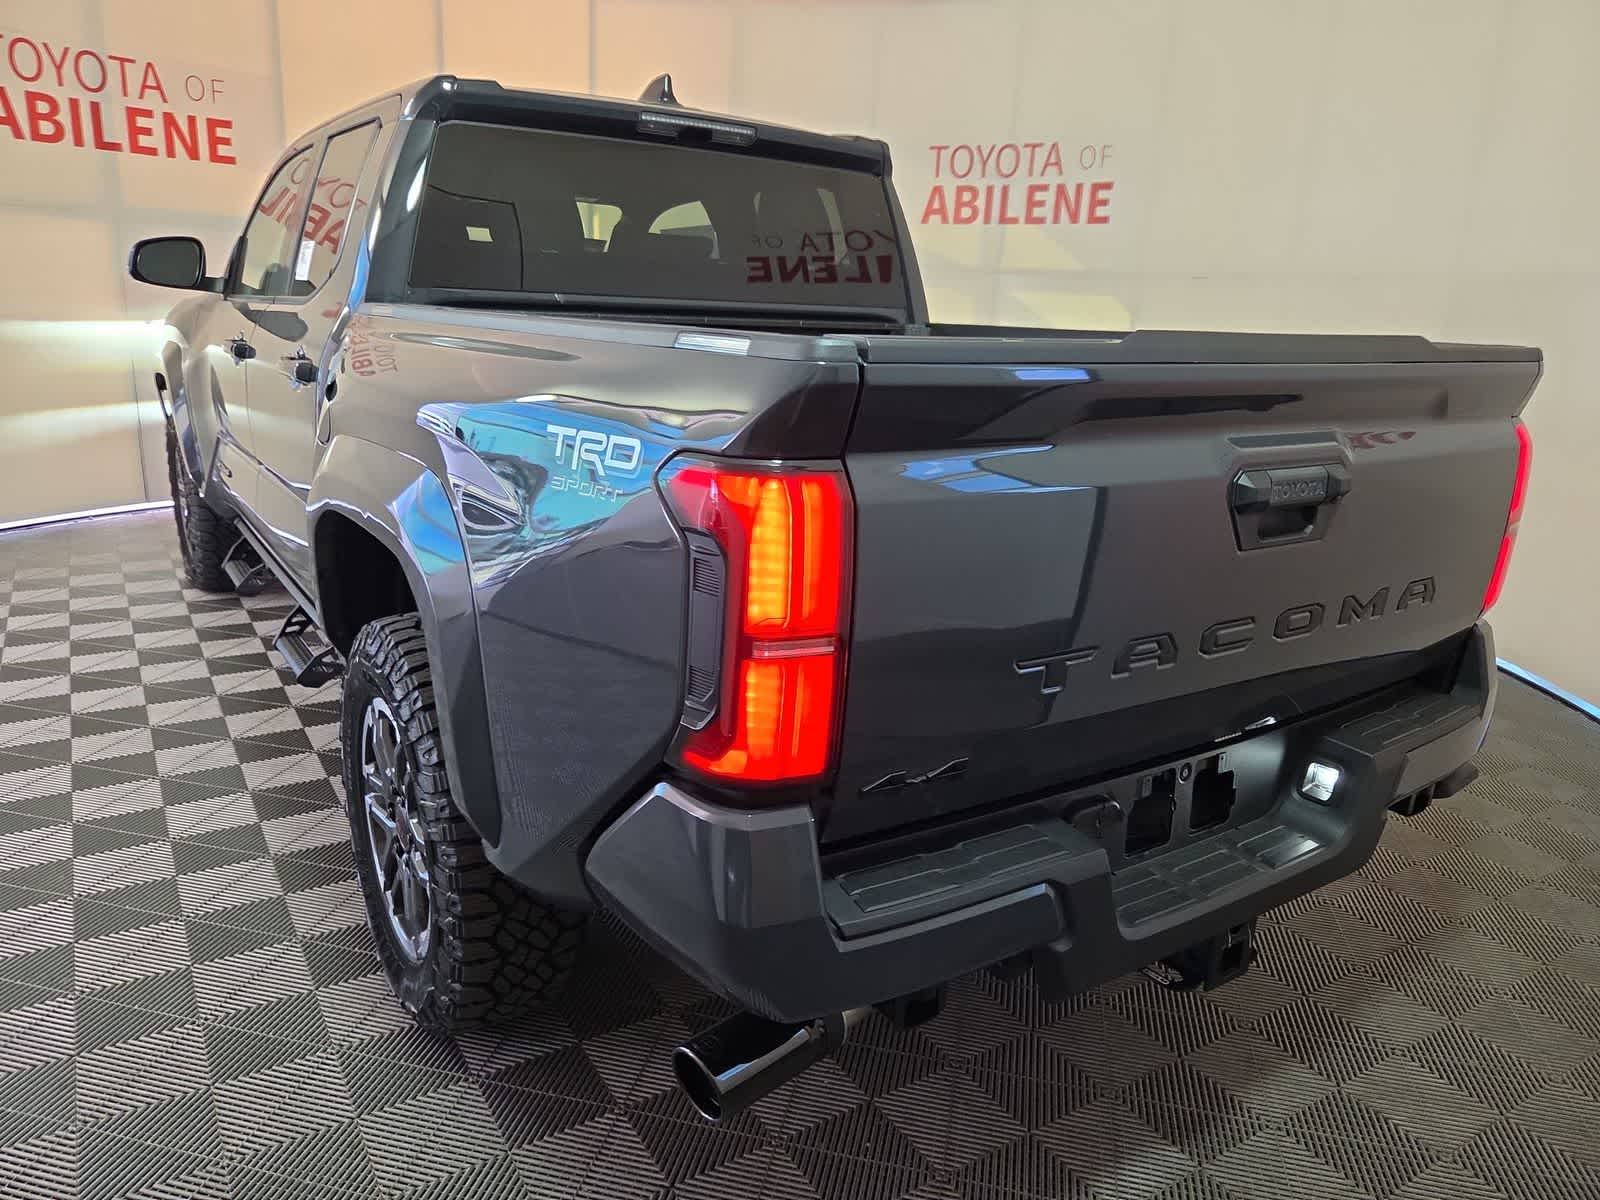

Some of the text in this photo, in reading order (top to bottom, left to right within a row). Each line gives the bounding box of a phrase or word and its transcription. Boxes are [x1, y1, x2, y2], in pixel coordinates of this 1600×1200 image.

[0, 34, 225, 104] OYOTA OF
[0, 86, 237, 165] ABILENE
[928, 141, 1115, 179] TOYOTA OF
[920, 181, 1115, 225] ABILENE
[546, 424, 642, 477] TRD
[551, 474, 624, 503] SPORT
[1271, 480, 1326, 500] TOYOTA
[1012, 575, 1437, 695] TACOMA
